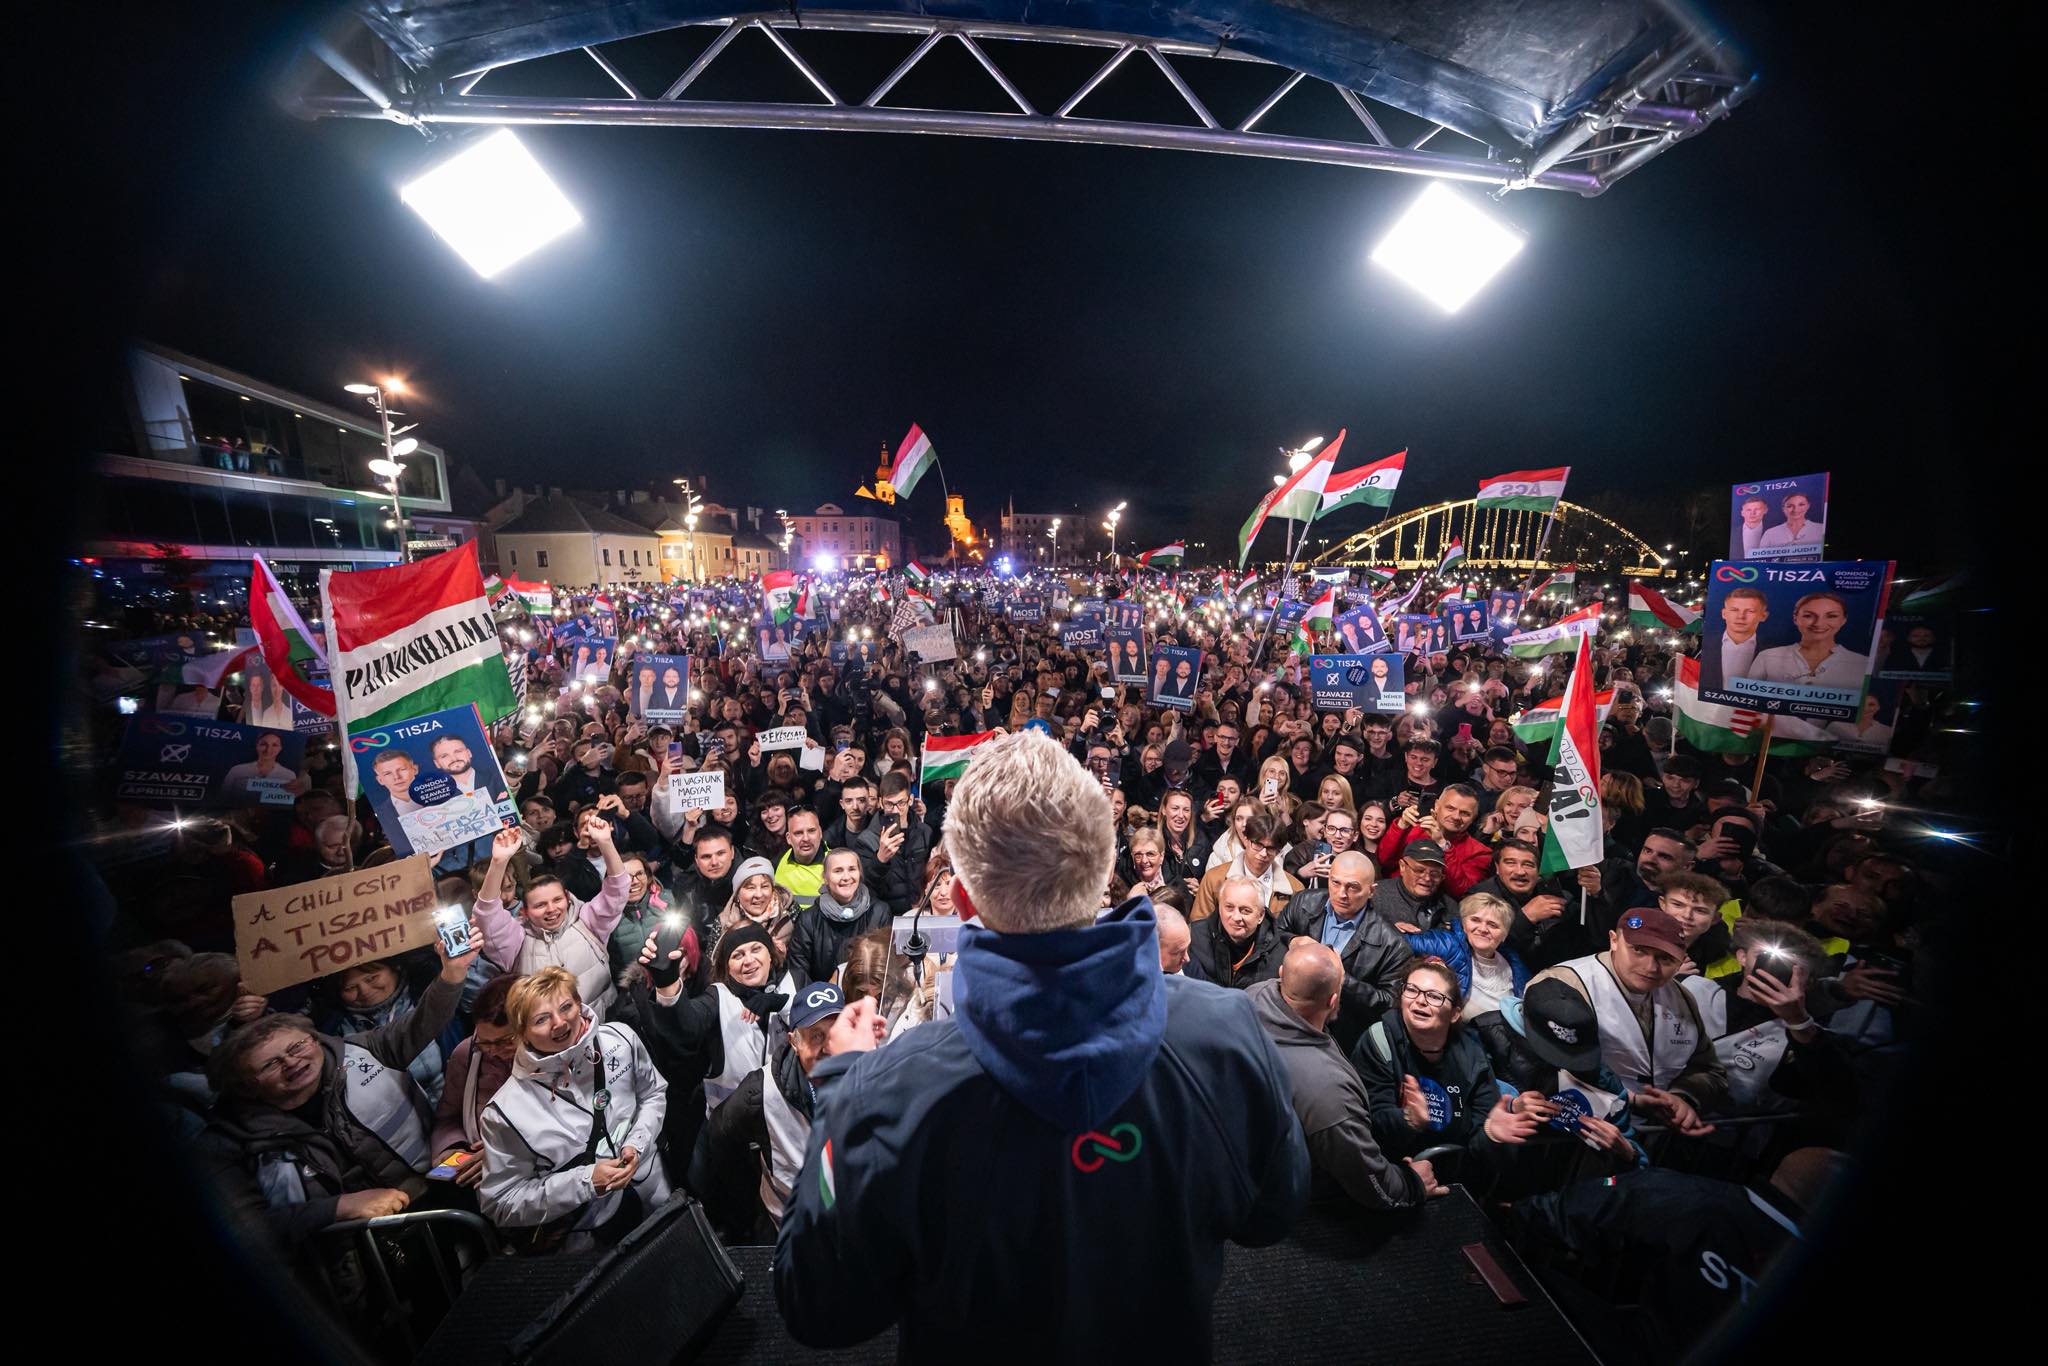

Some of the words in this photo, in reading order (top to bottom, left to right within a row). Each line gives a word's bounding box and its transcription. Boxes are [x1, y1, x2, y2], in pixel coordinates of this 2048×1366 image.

[1765, 481, 1797, 490] TISZA
[1752, 548, 1790, 556] DIÓSZEGI
[1766, 570, 1826, 582] TISZA
[1013, 609, 1038, 617] MOST
[1064, 629, 1098, 642] MOST
[1171, 649, 1188, 657] TISZA
[1735, 681, 1800, 697] DIÓSZEGI
[1804, 691, 1853, 701] JUDIT
[1704, 691, 1758, 706] SZAVAZZ!
[1794, 704, 1830, 714] ÁPRILIS
[194, 726, 242, 741] TISZA
[394, 719, 443, 740] TISZA
[124, 771, 209, 784] SZAVAZZ!
[672, 778, 682, 787] MI
[684, 774, 722, 786] VAGYUNK
[126, 785, 180, 797] ÁPRILIS
[183, 787, 198, 797] 12.
[413, 777, 449, 792] GONDOLJ
[678, 785, 712, 797] MAGYAR
[265, 792, 292, 800] JUDIT
[420, 786, 451, 801] SZAVAZZ
[681, 796, 710, 808] PÉTER
[250, 903, 276, 924] A
[251, 937, 281, 959] A
[284, 907, 378, 946] TISZA
[384, 891, 434, 920] NYER
[300, 924, 406, 974] PONT!
[605, 1044, 622, 1057] TISZA
